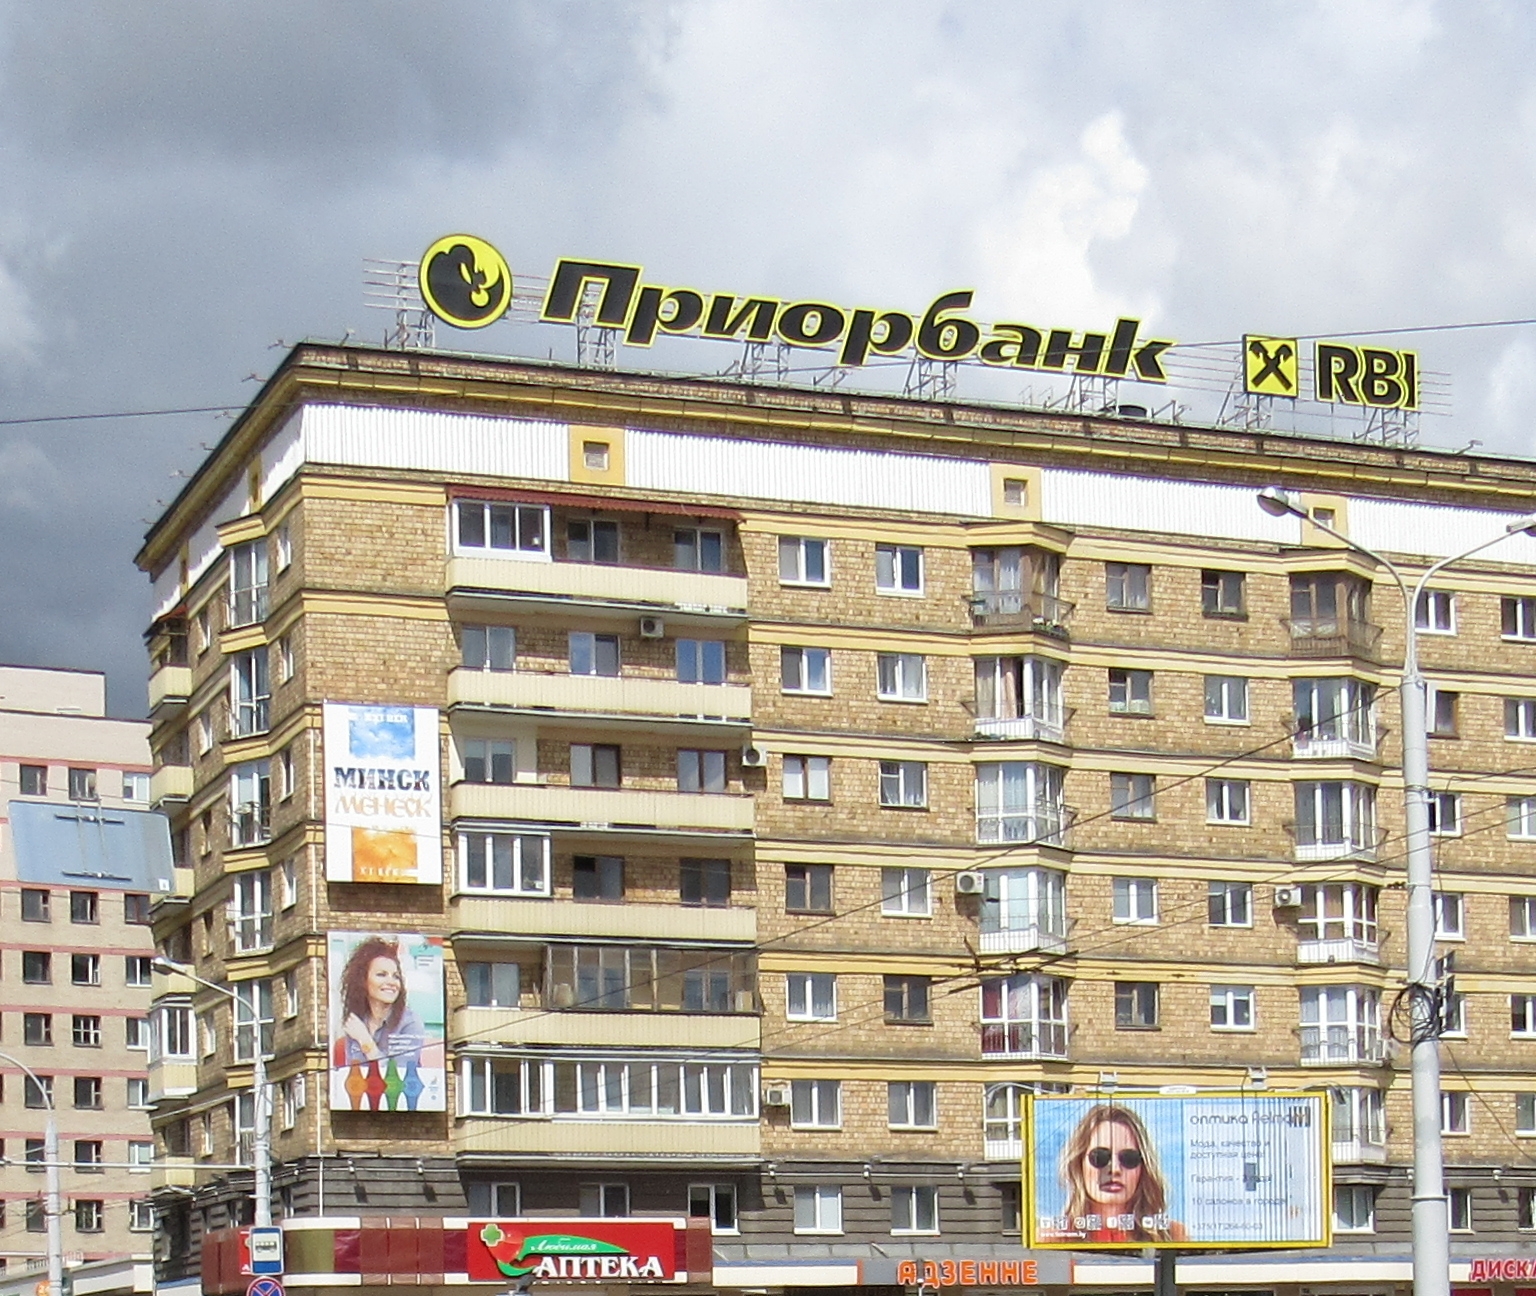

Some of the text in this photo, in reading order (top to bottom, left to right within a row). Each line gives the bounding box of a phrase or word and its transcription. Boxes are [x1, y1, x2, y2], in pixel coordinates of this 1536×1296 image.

[540, 257, 1175, 384] Приорбанк
[1315, 341, 1419, 409] RBI
[334, 767, 430, 792] МИНСК
[1190, 1114, 1248, 1125] оптика
[531, 1237, 598, 1251] Любимая
[532, 1256, 664, 1279] АПТЕКА
[897, 1259, 1039, 1289] АДЗЕННЕ
